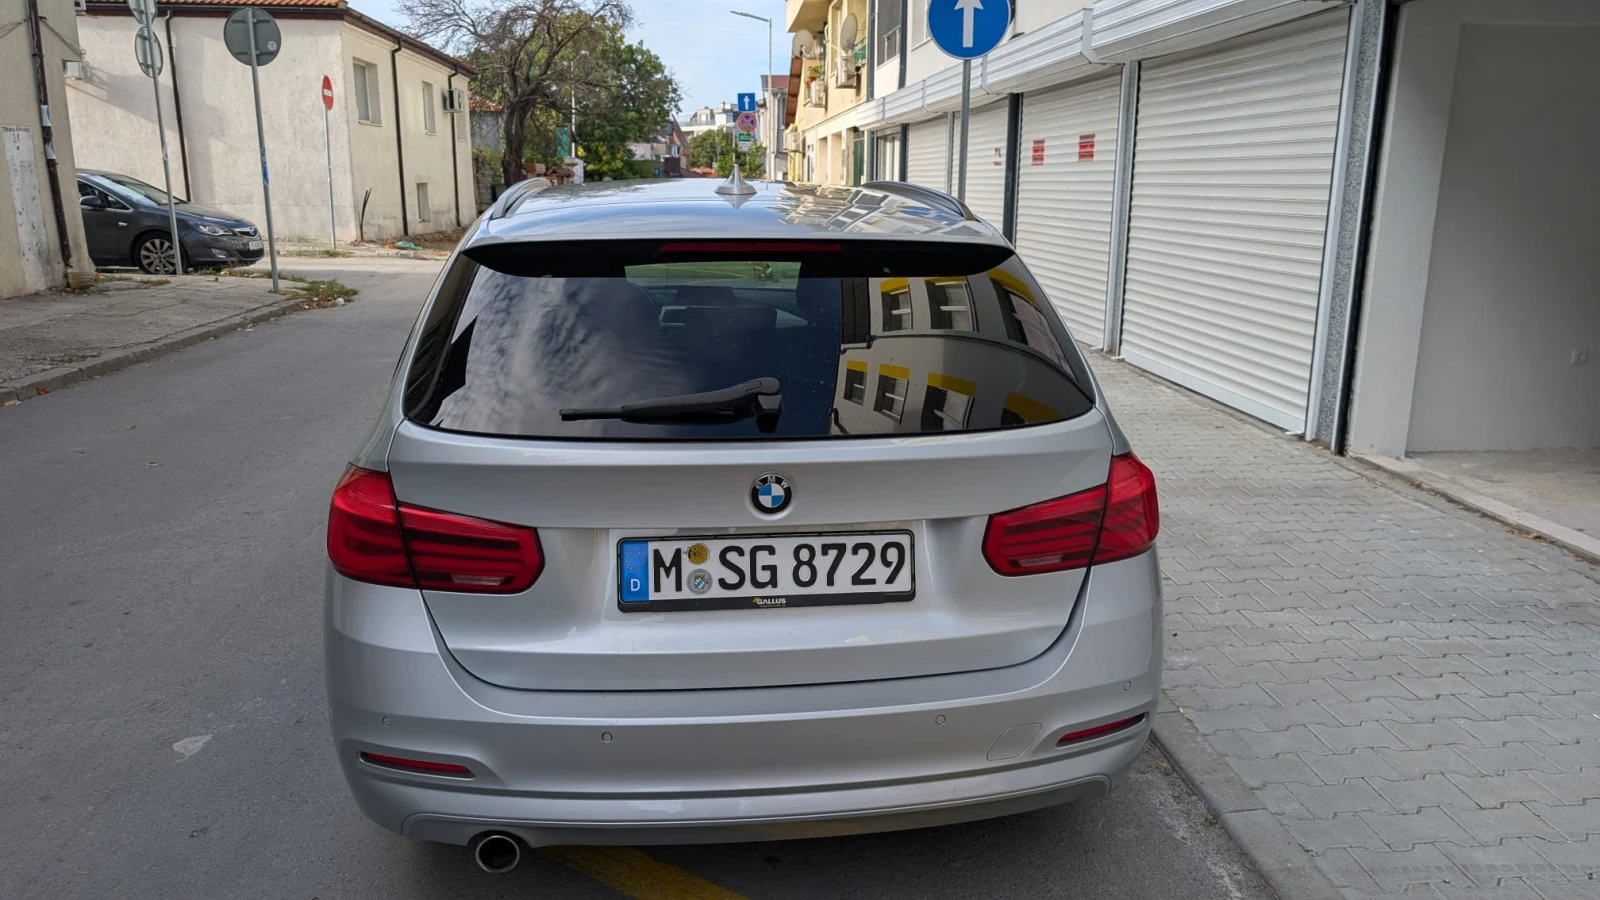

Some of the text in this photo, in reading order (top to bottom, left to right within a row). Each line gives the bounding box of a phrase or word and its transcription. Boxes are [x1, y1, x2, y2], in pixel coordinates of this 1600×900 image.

[755, 475, 789, 490] BMW
[653, 547, 682, 593] M
[718, 544, 778, 590] SG
[792, 541, 906, 588] 8729
[630, 579, 640, 592] D
[757, 597, 786, 605] GALLUS
